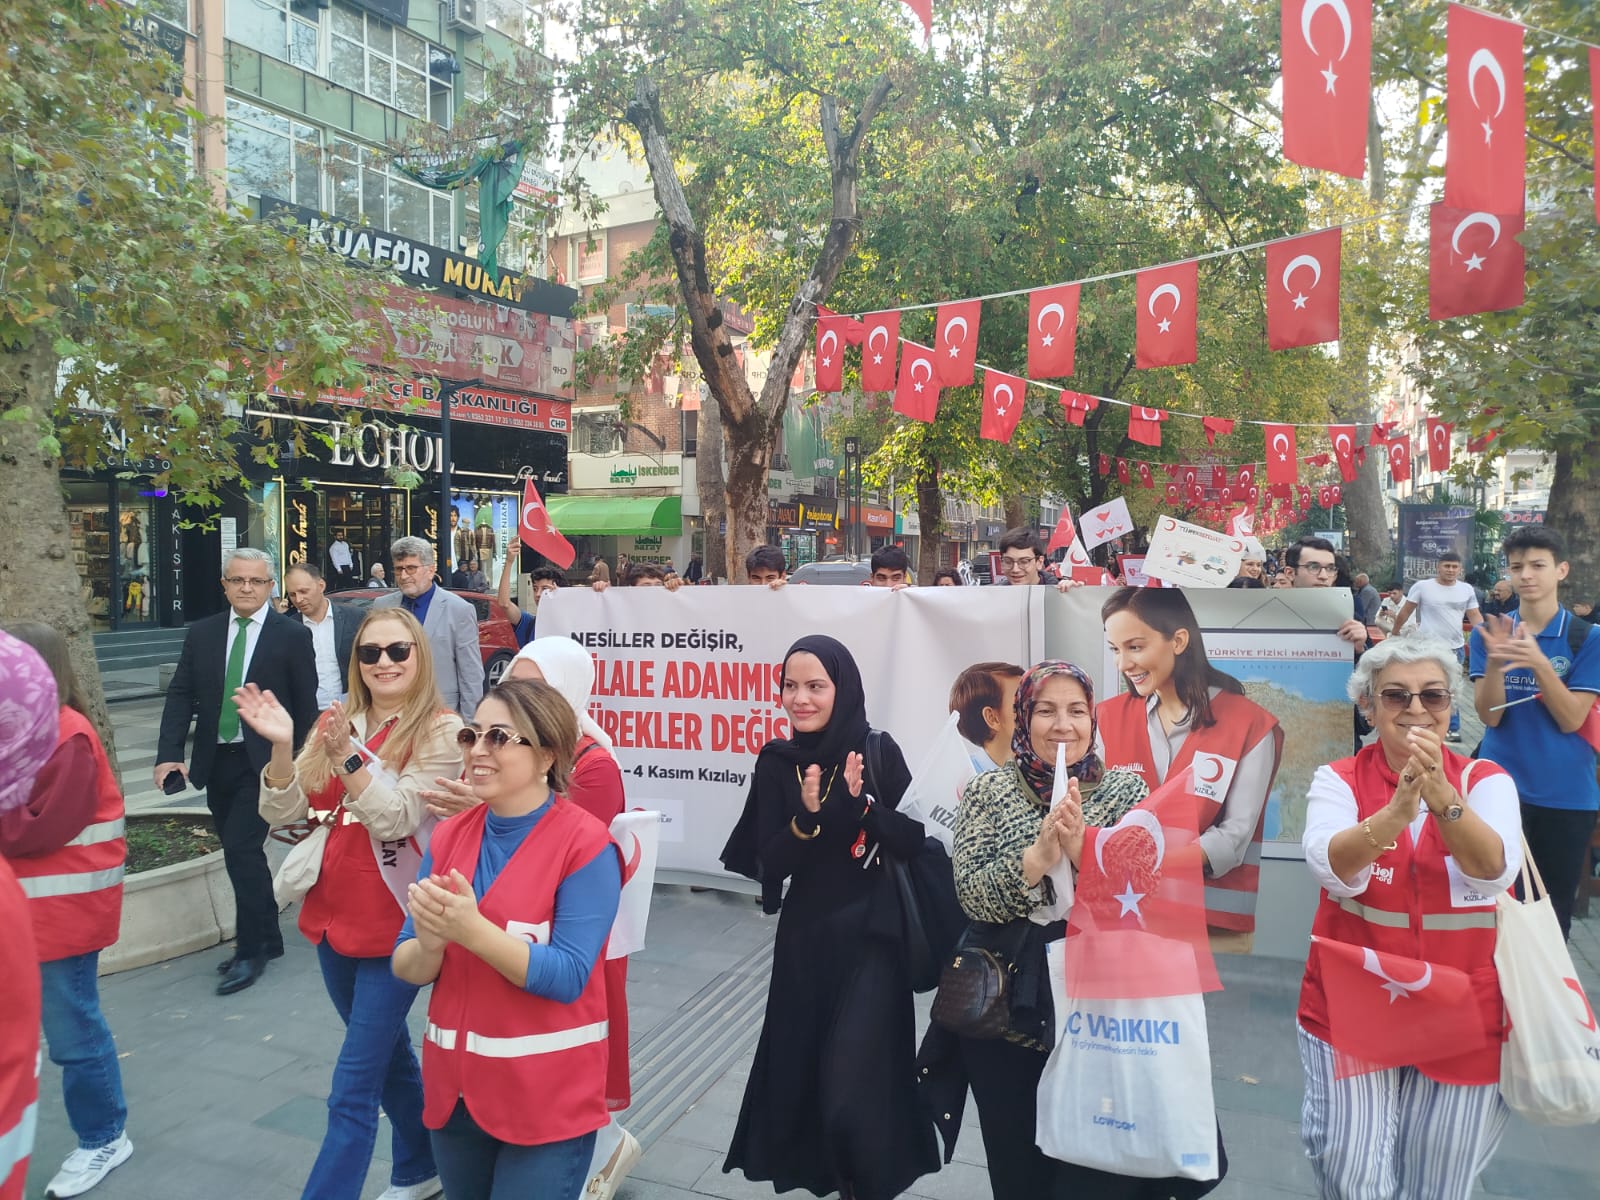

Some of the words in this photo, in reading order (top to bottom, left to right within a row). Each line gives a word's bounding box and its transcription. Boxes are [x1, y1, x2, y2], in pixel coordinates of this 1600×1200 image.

[308, 218, 430, 278] KUAFÖR
[443, 257, 522, 303] MURAT
[551, 419, 566, 430] CHP
[610, 476, 637, 486] saray
[638, 465, 679, 477] İSKENDER
[571, 628, 655, 649] NESİLLER
[661, 629, 743, 652] DEĞİŞİR,
[1207, 648, 1253, 656] TÜRKİYE
[1257, 648, 1287, 657] FİZİKİ
[1291, 649, 1342, 658] HARİTASI
[590, 652, 655, 698] İLALE
[588, 702, 702, 751] ÜREKLER
[648, 765, 694, 780] Kasım
[698, 768, 747, 787] Kızılay
[1087, 1012, 1180, 1045] WAIKIKI
